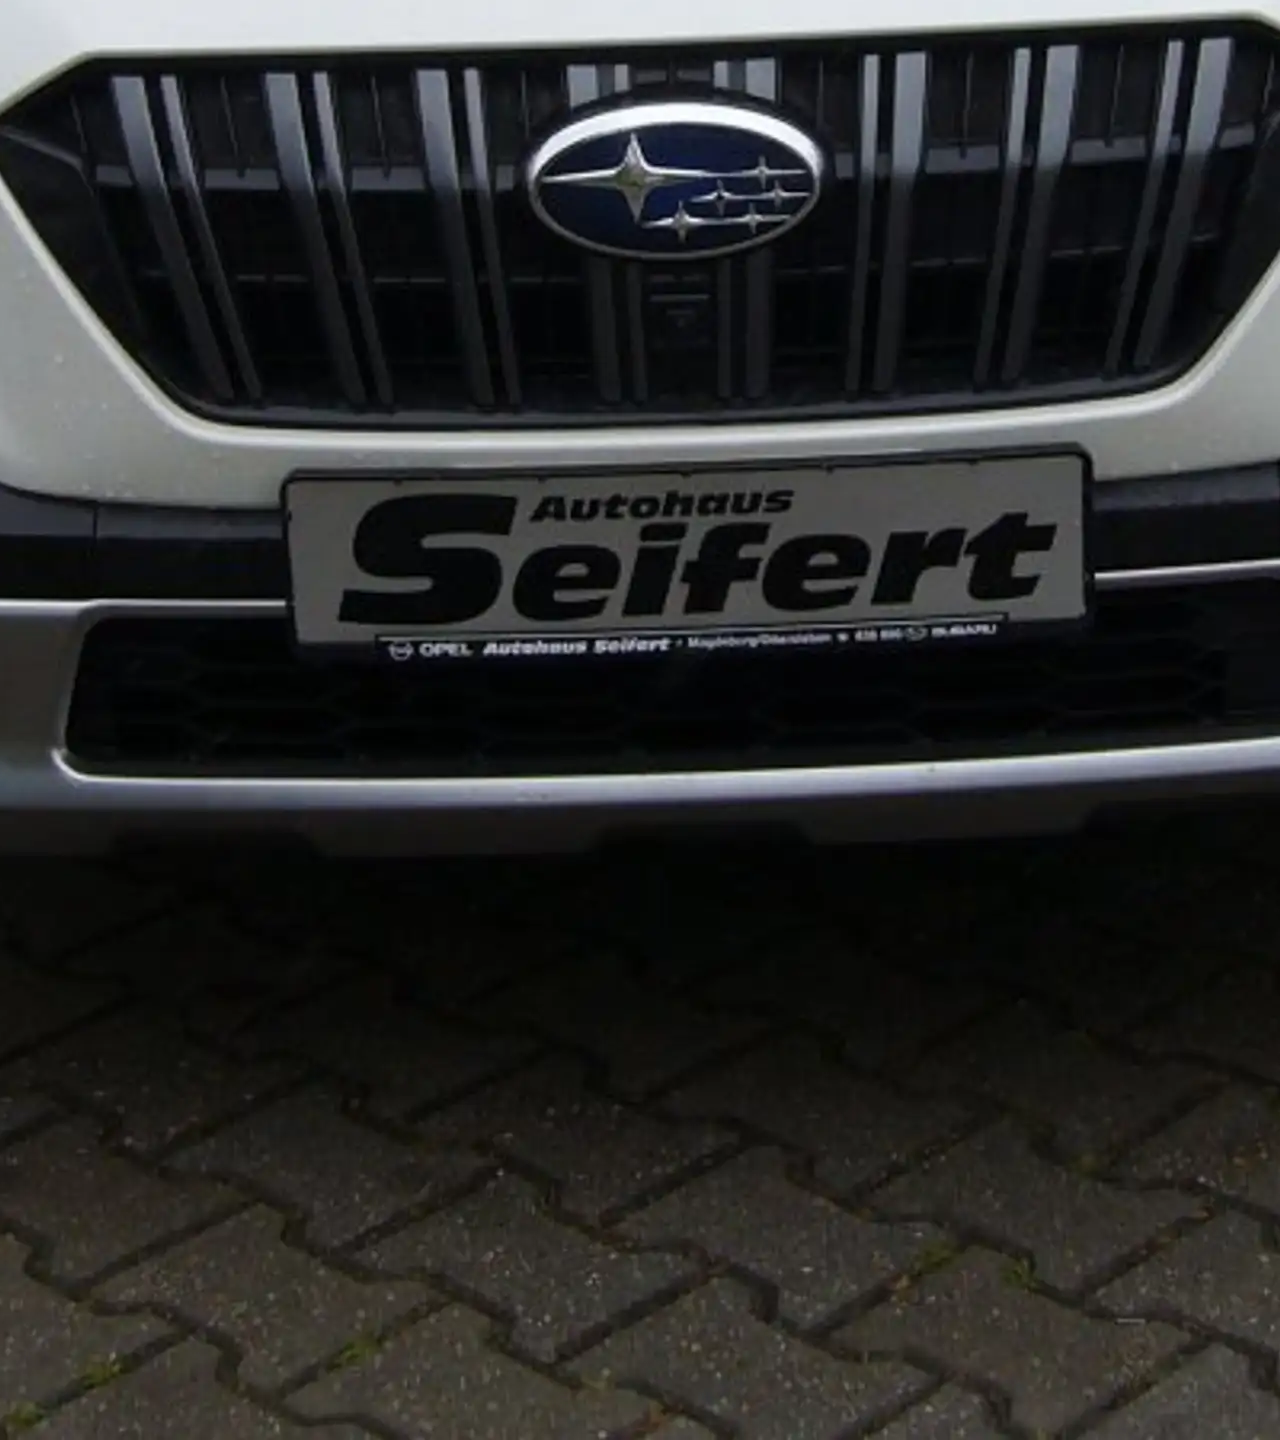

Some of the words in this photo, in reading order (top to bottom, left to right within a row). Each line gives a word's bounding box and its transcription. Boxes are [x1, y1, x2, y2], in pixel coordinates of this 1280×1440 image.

[529, 488, 795, 525] Autohaus
[337, 493, 1058, 627] Seifert
[419, 643, 474, 658] OPEL
[483, 640, 588, 657] Autohaus
[593, 637, 673, 655] Seifert
